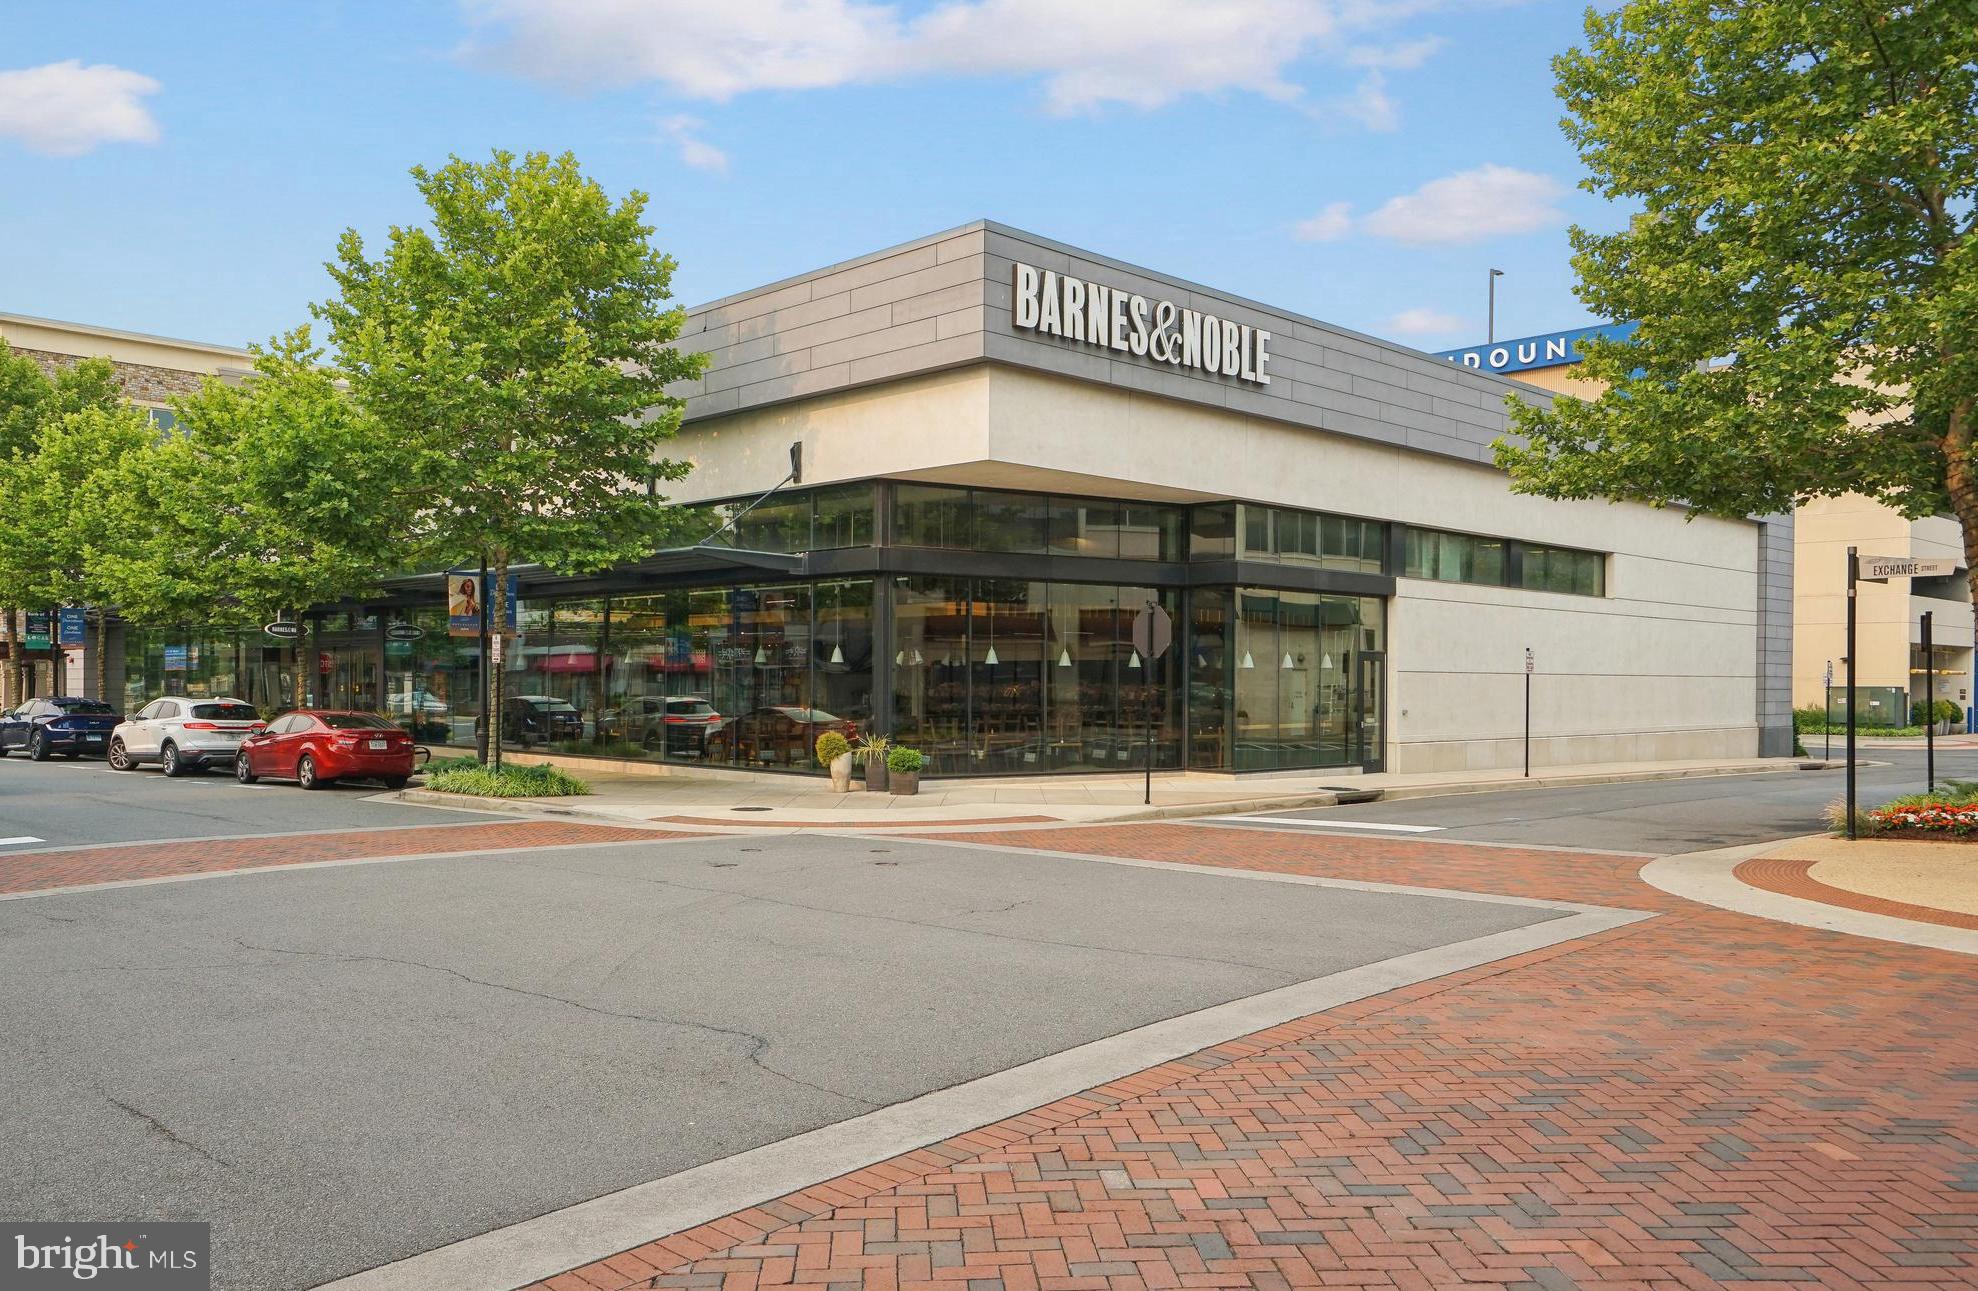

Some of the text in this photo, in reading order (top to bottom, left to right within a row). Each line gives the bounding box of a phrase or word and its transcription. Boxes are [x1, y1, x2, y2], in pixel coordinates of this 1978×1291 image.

[1448, 337, 1566, 369] DOUN
[1873, 563, 1938, 576] EXCHANGE STREET
